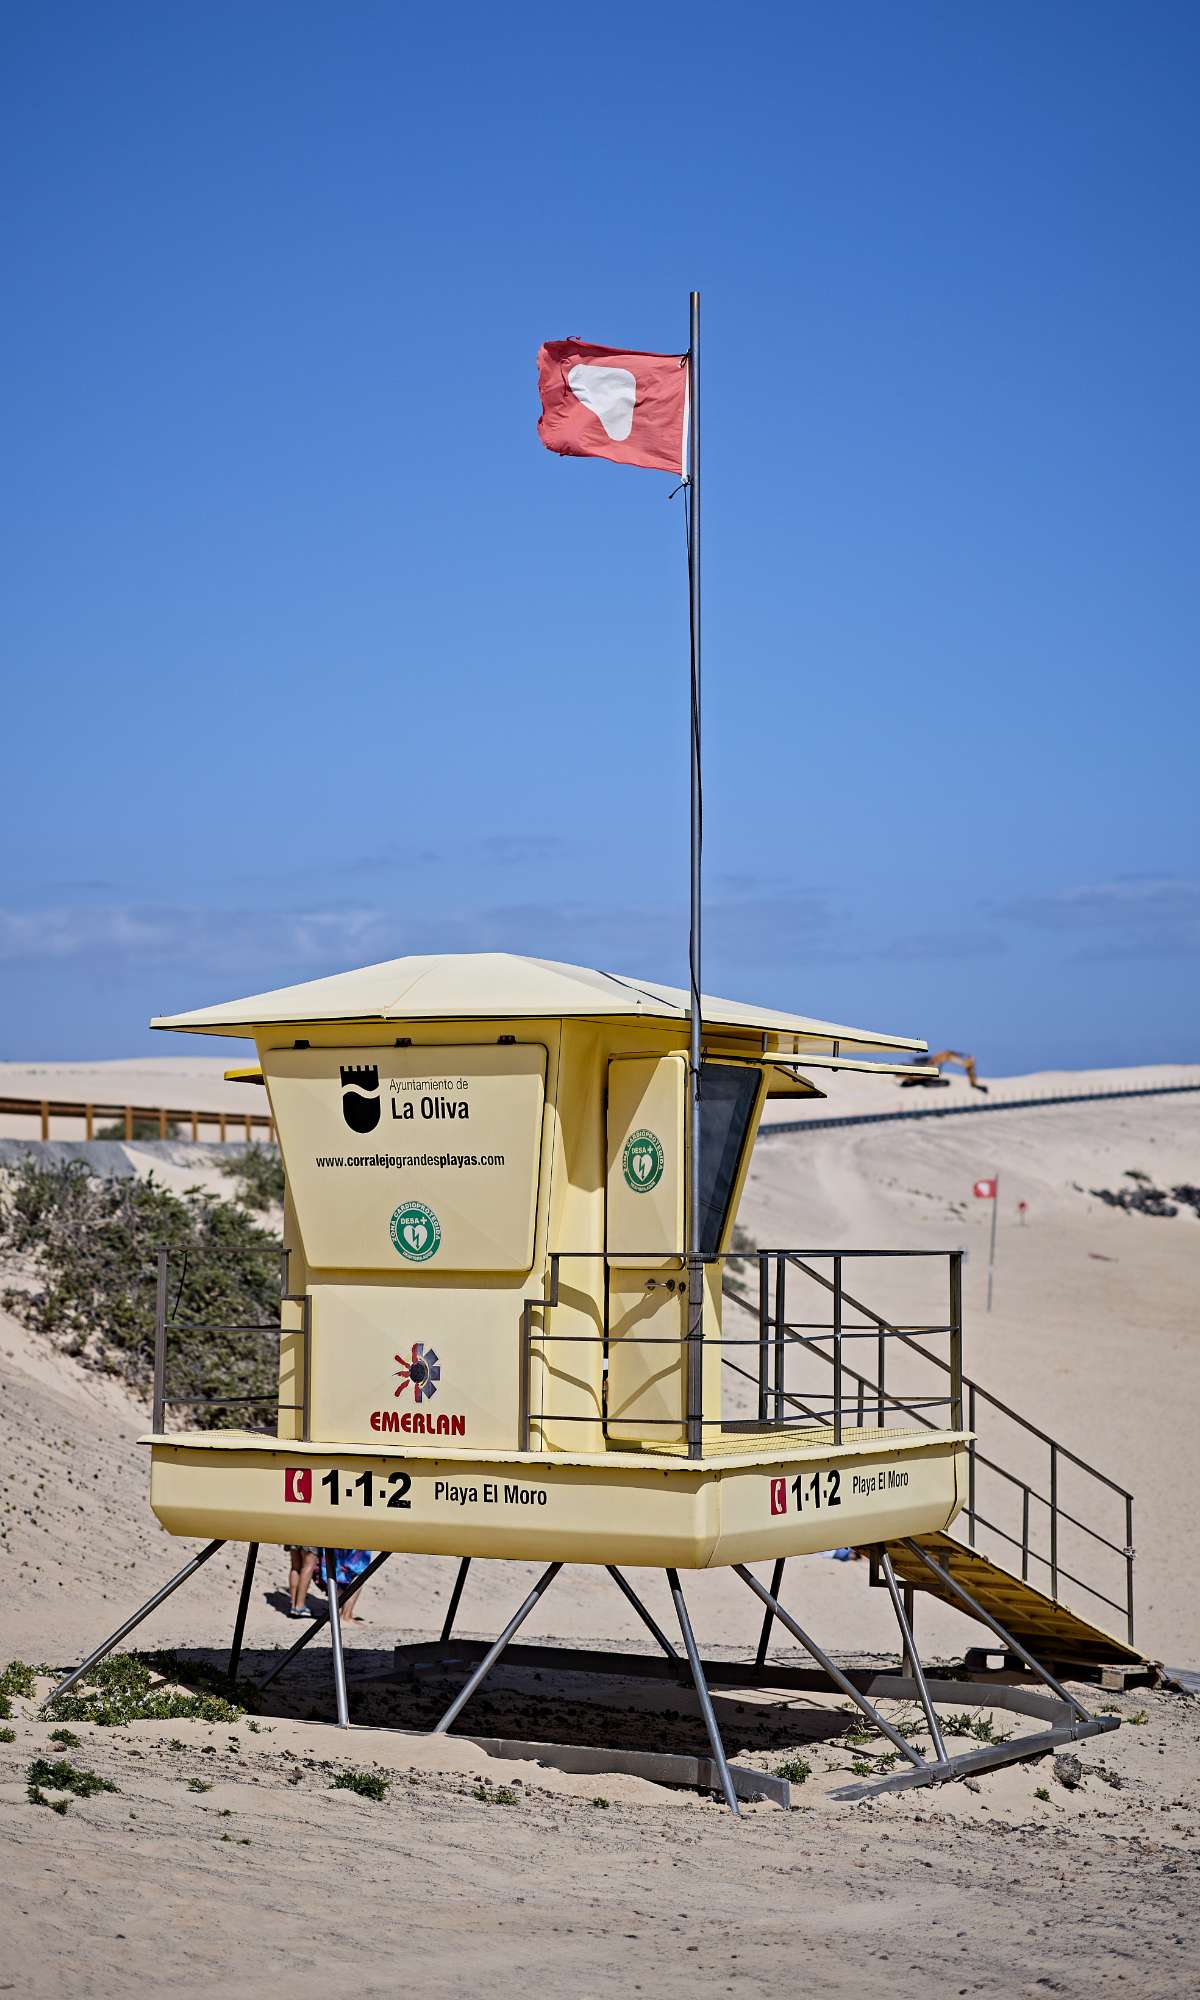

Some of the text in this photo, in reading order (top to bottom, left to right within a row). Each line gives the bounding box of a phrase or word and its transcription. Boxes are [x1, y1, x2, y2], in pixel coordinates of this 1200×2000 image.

[390, 1078, 469, 1093] Ayuntamiento de
[391, 1096, 469, 1119] La Oliva
[316, 1153, 505, 1169] www.corralejograndesplayas.com
[370, 1411, 466, 1436] EMERLAN
[434, 1481, 478, 1506] Playa
[483, 1483, 498, 1503] El
[504, 1485, 547, 1506] Moro
[852, 1475, 876, 1496] Playa
[878, 1471, 886, 1490] El
[888, 1470, 909, 1488] Moro
